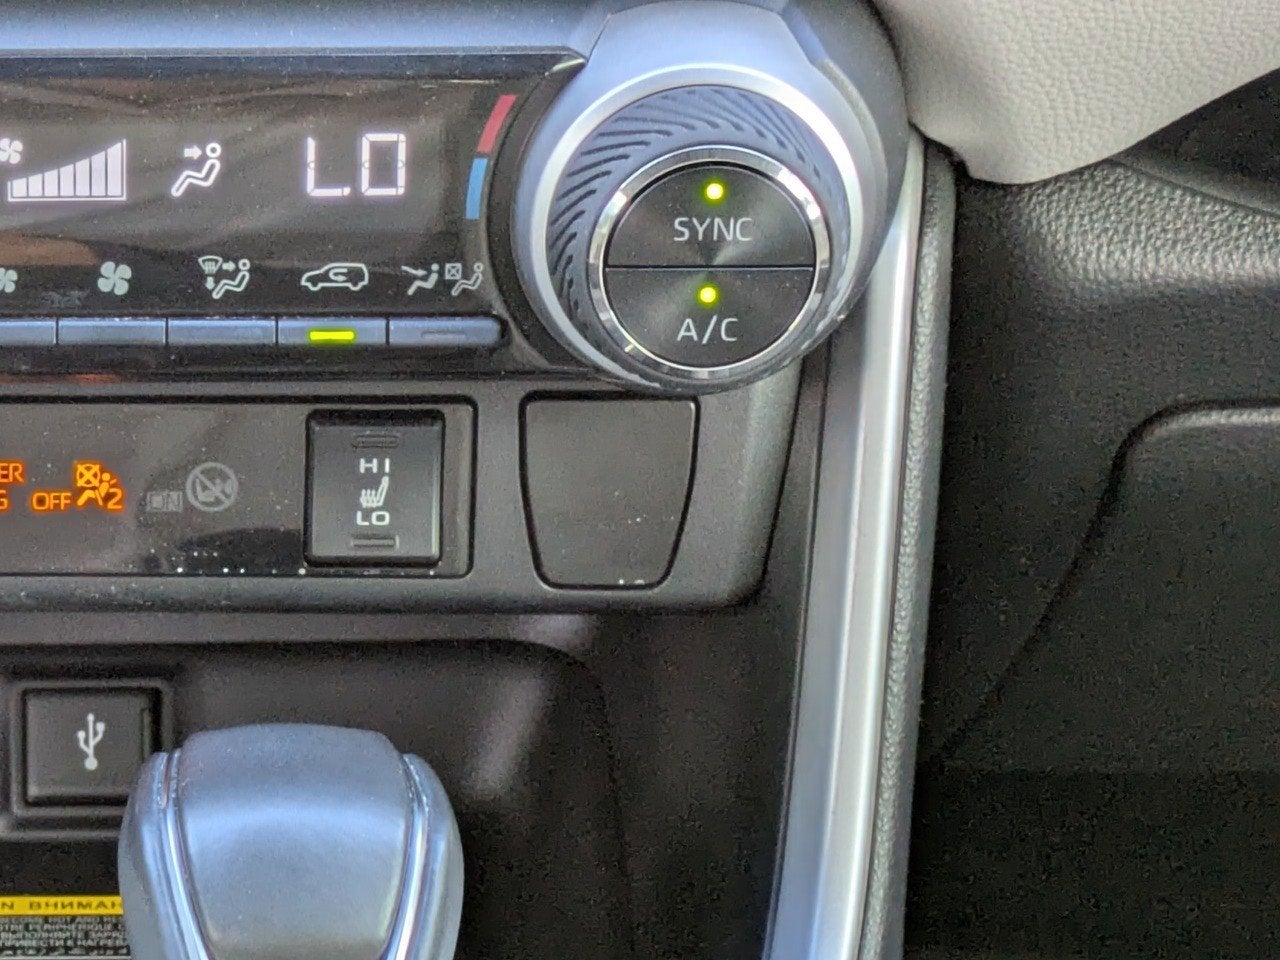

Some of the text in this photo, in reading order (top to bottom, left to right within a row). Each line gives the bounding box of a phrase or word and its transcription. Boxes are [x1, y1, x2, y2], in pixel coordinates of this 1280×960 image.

[306, 132, 406, 196] LO
[673, 217, 753, 242] SYNC
[677, 315, 739, 344] A/C
[359, 457, 391, 474] HI
[31, 491, 72, 511] OFF
[356, 509, 391, 526] LO
